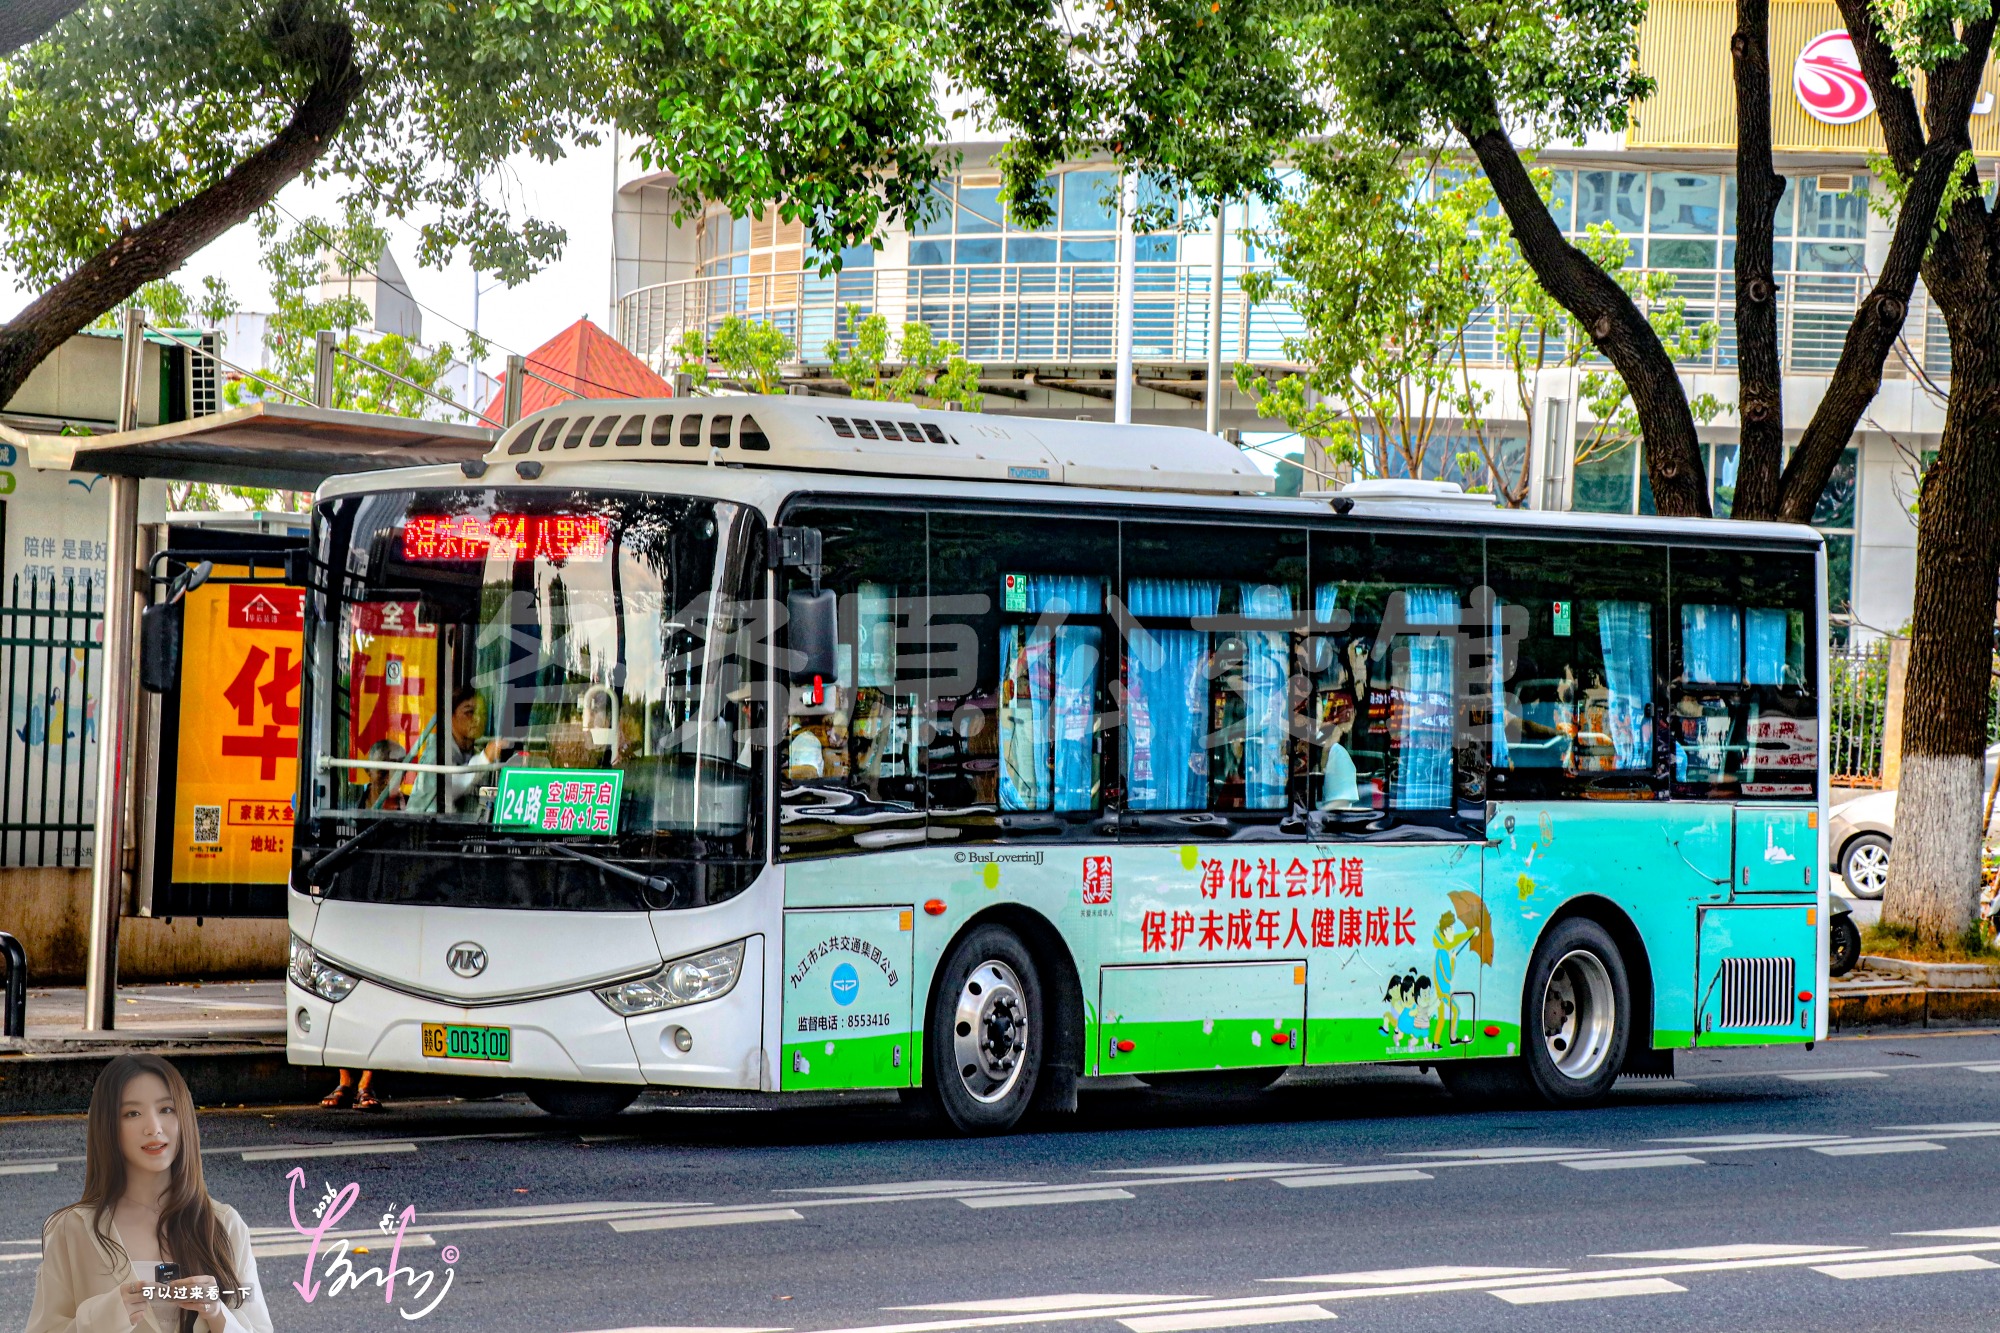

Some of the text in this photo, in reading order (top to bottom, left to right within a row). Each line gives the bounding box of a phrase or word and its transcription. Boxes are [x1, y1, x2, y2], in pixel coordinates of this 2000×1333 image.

[24, 536, 56, 559] 陪伴
[493, 517, 526, 559] 24
[532, 518, 608, 558] 八里湖
[503, 785, 542, 824] 24路
[546, 780, 613, 805] 空调开启
[240, 804, 295, 821] 家装大全
[542, 805, 610, 831] 票价+1元
[250, 835, 285, 853] 地址：
[1199, 857, 1364, 900] 净化社会环境
[1140, 906, 1417, 953] 保护未成年人健康成长
[790, 936, 899, 990] 九江市公共交通集团公司
